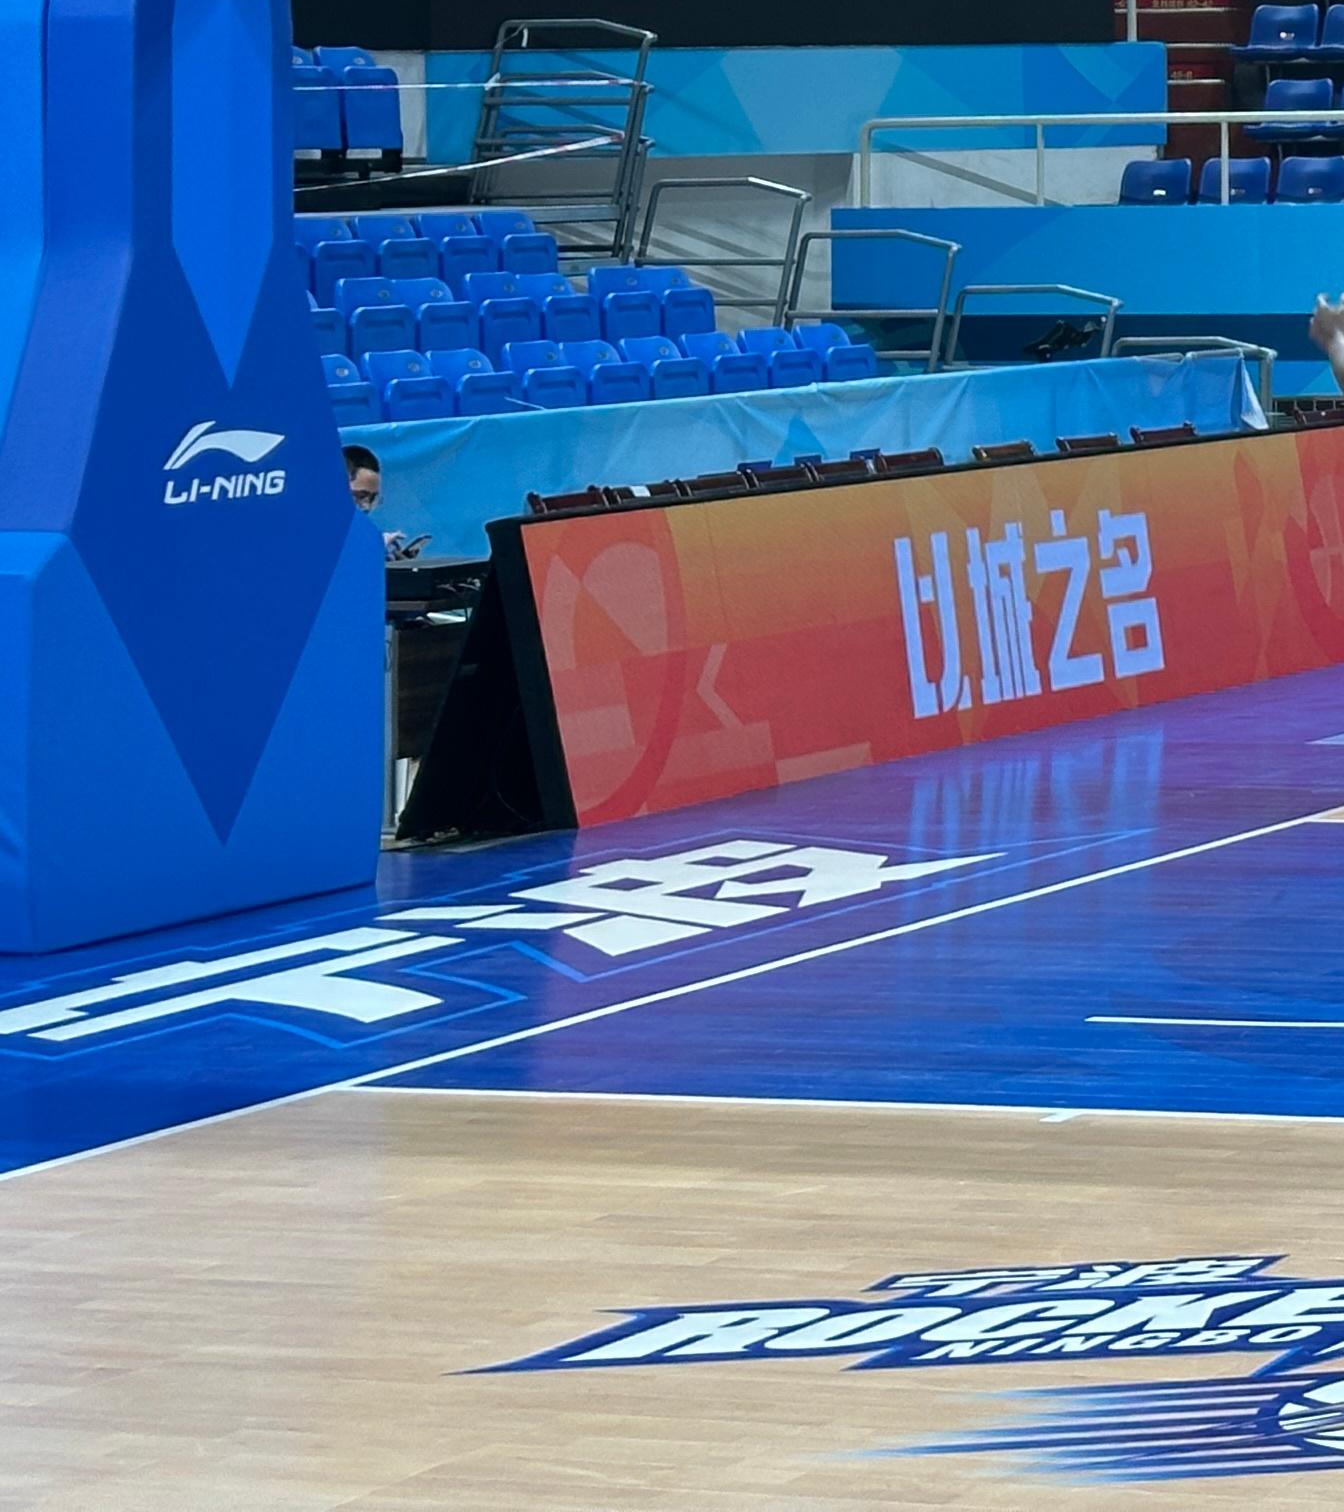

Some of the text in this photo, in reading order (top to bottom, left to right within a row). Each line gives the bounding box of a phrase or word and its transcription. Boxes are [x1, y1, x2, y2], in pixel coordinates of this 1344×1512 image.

[163, 469, 286, 505] LI-NING
[893, 508, 1166, 720] 以城之名
[915, 1322, 1324, 1361] NINGBO
